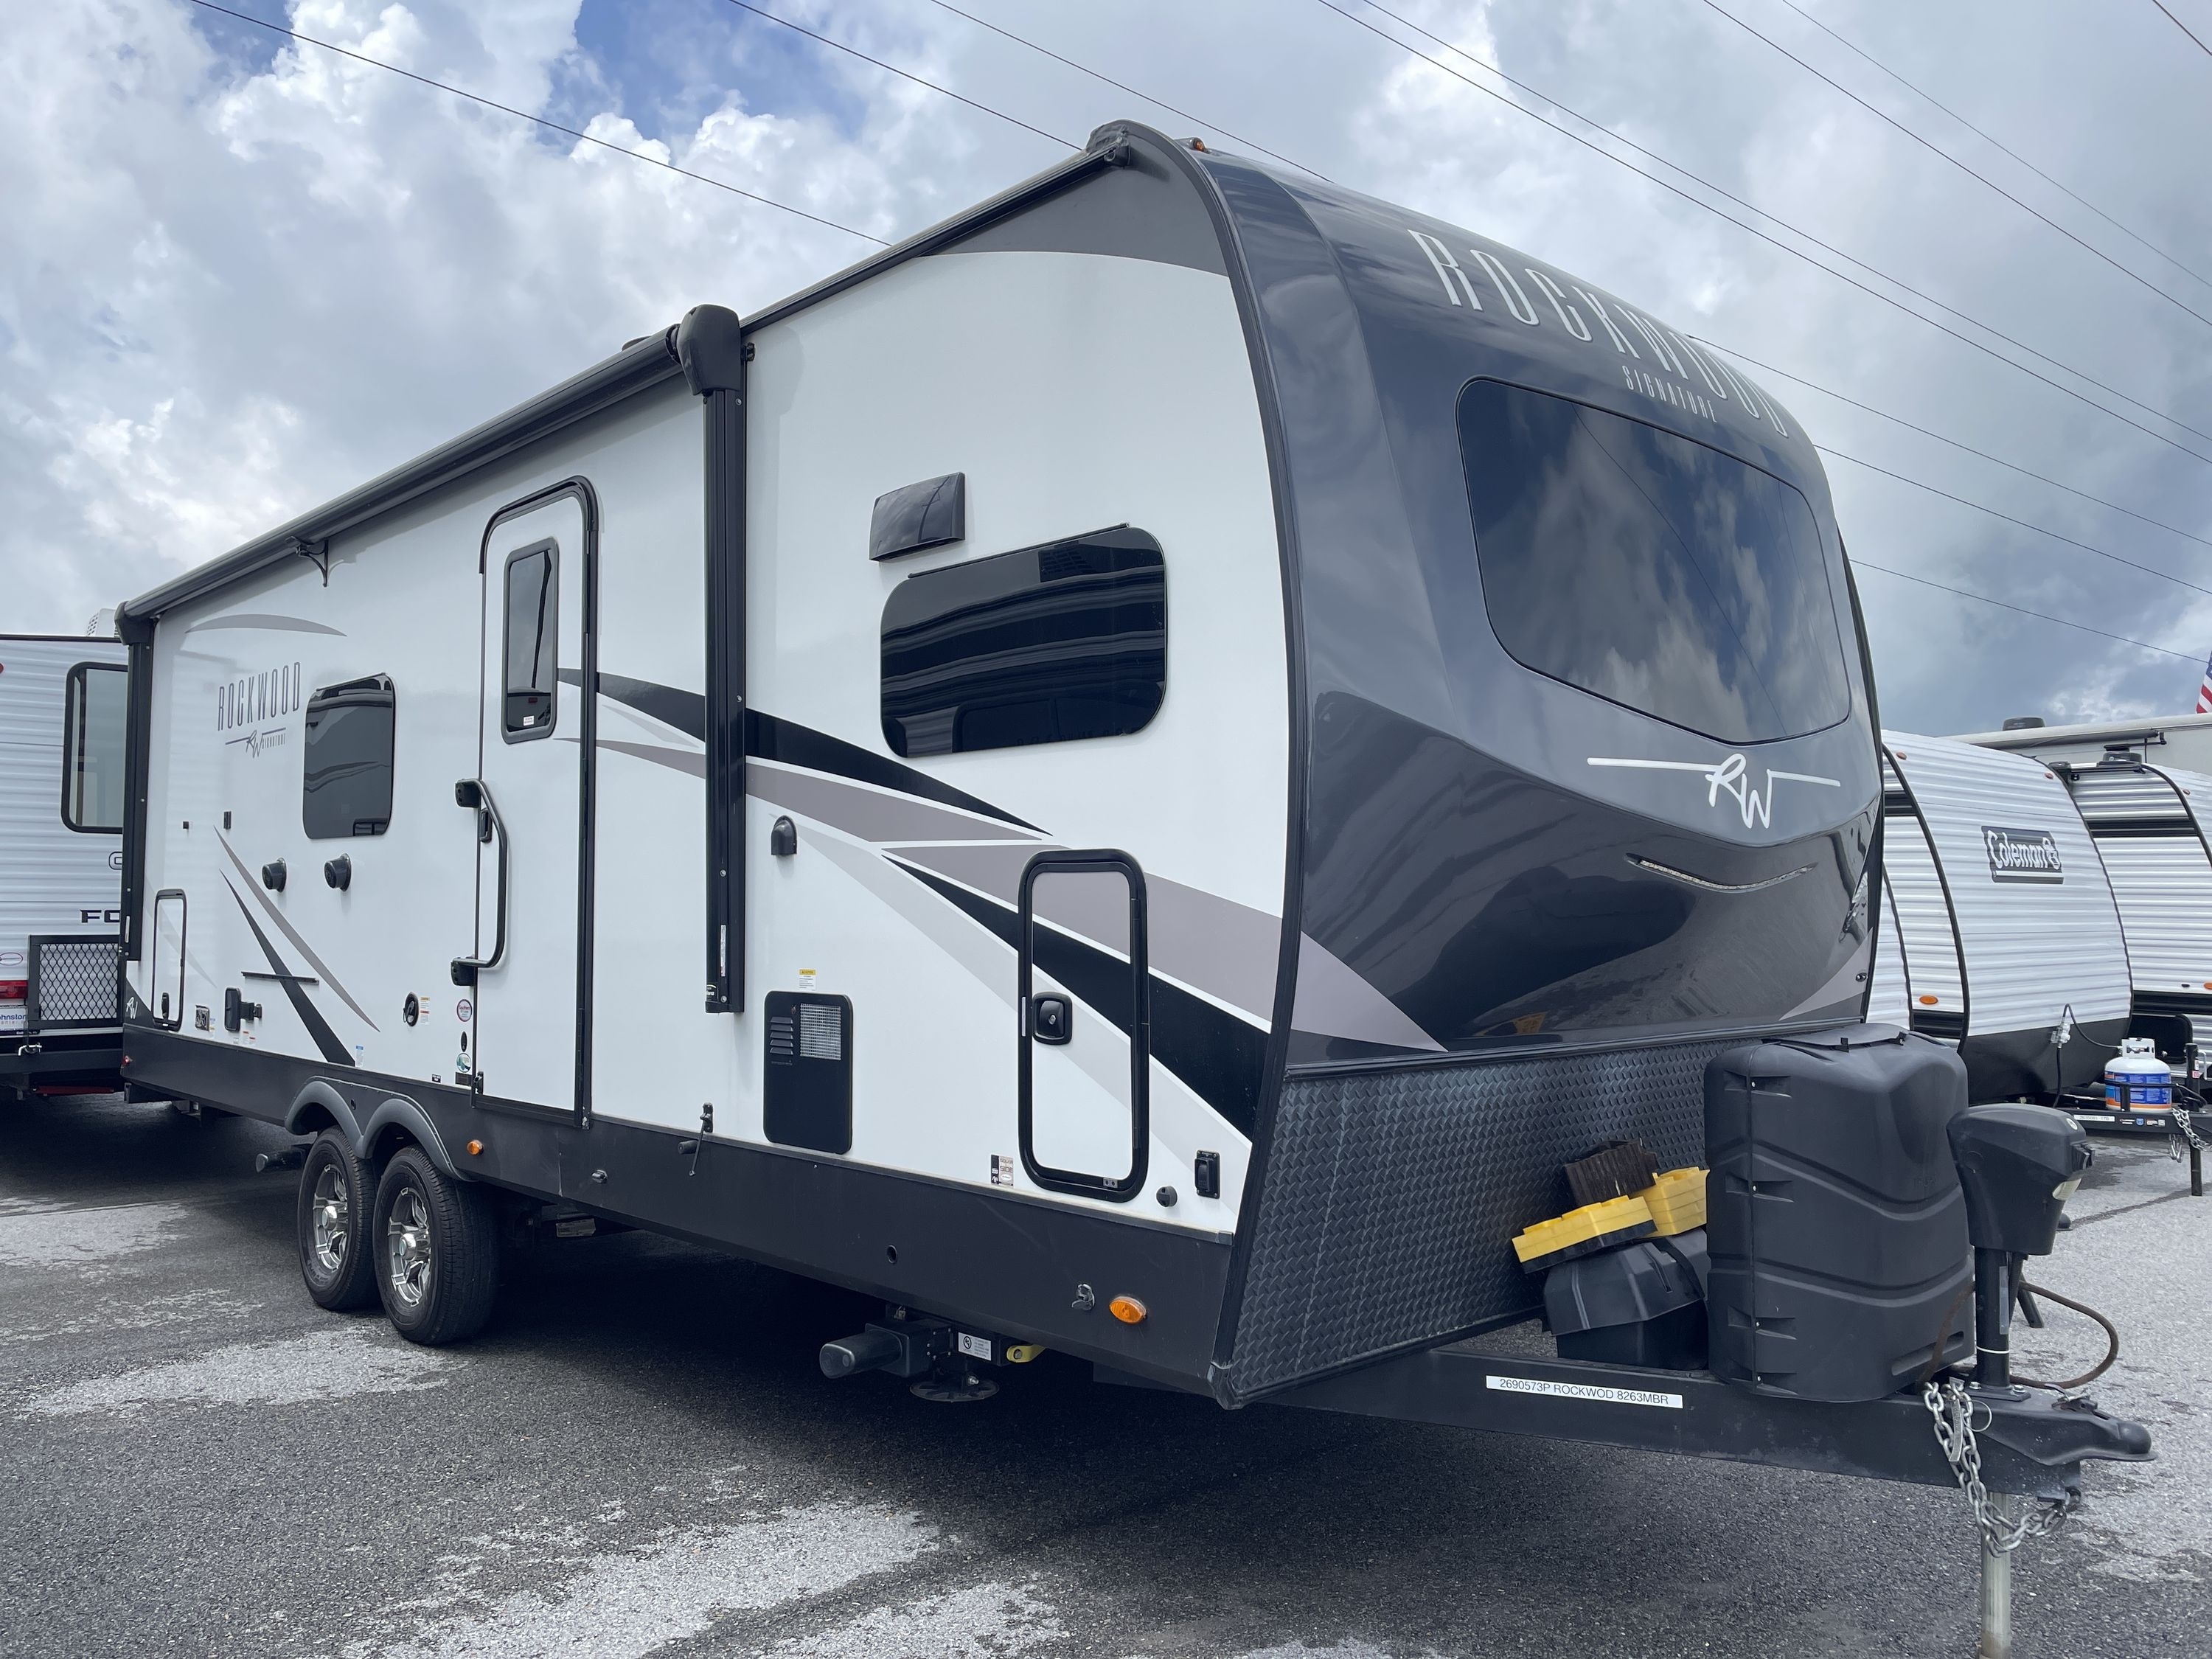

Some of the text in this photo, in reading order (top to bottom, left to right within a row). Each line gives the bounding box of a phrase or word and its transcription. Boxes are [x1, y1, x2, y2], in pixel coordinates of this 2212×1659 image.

[1407, 229, 1790, 438] ROCKWOOD
[1622, 365, 1717, 424] SIGNATURE
[218, 661, 300, 731] ROCKWOOD
[1987, 830, 2048, 869] Coleman
[1500, 1378, 1669, 1405] 2690573P ROCKWOD 8263MBR
